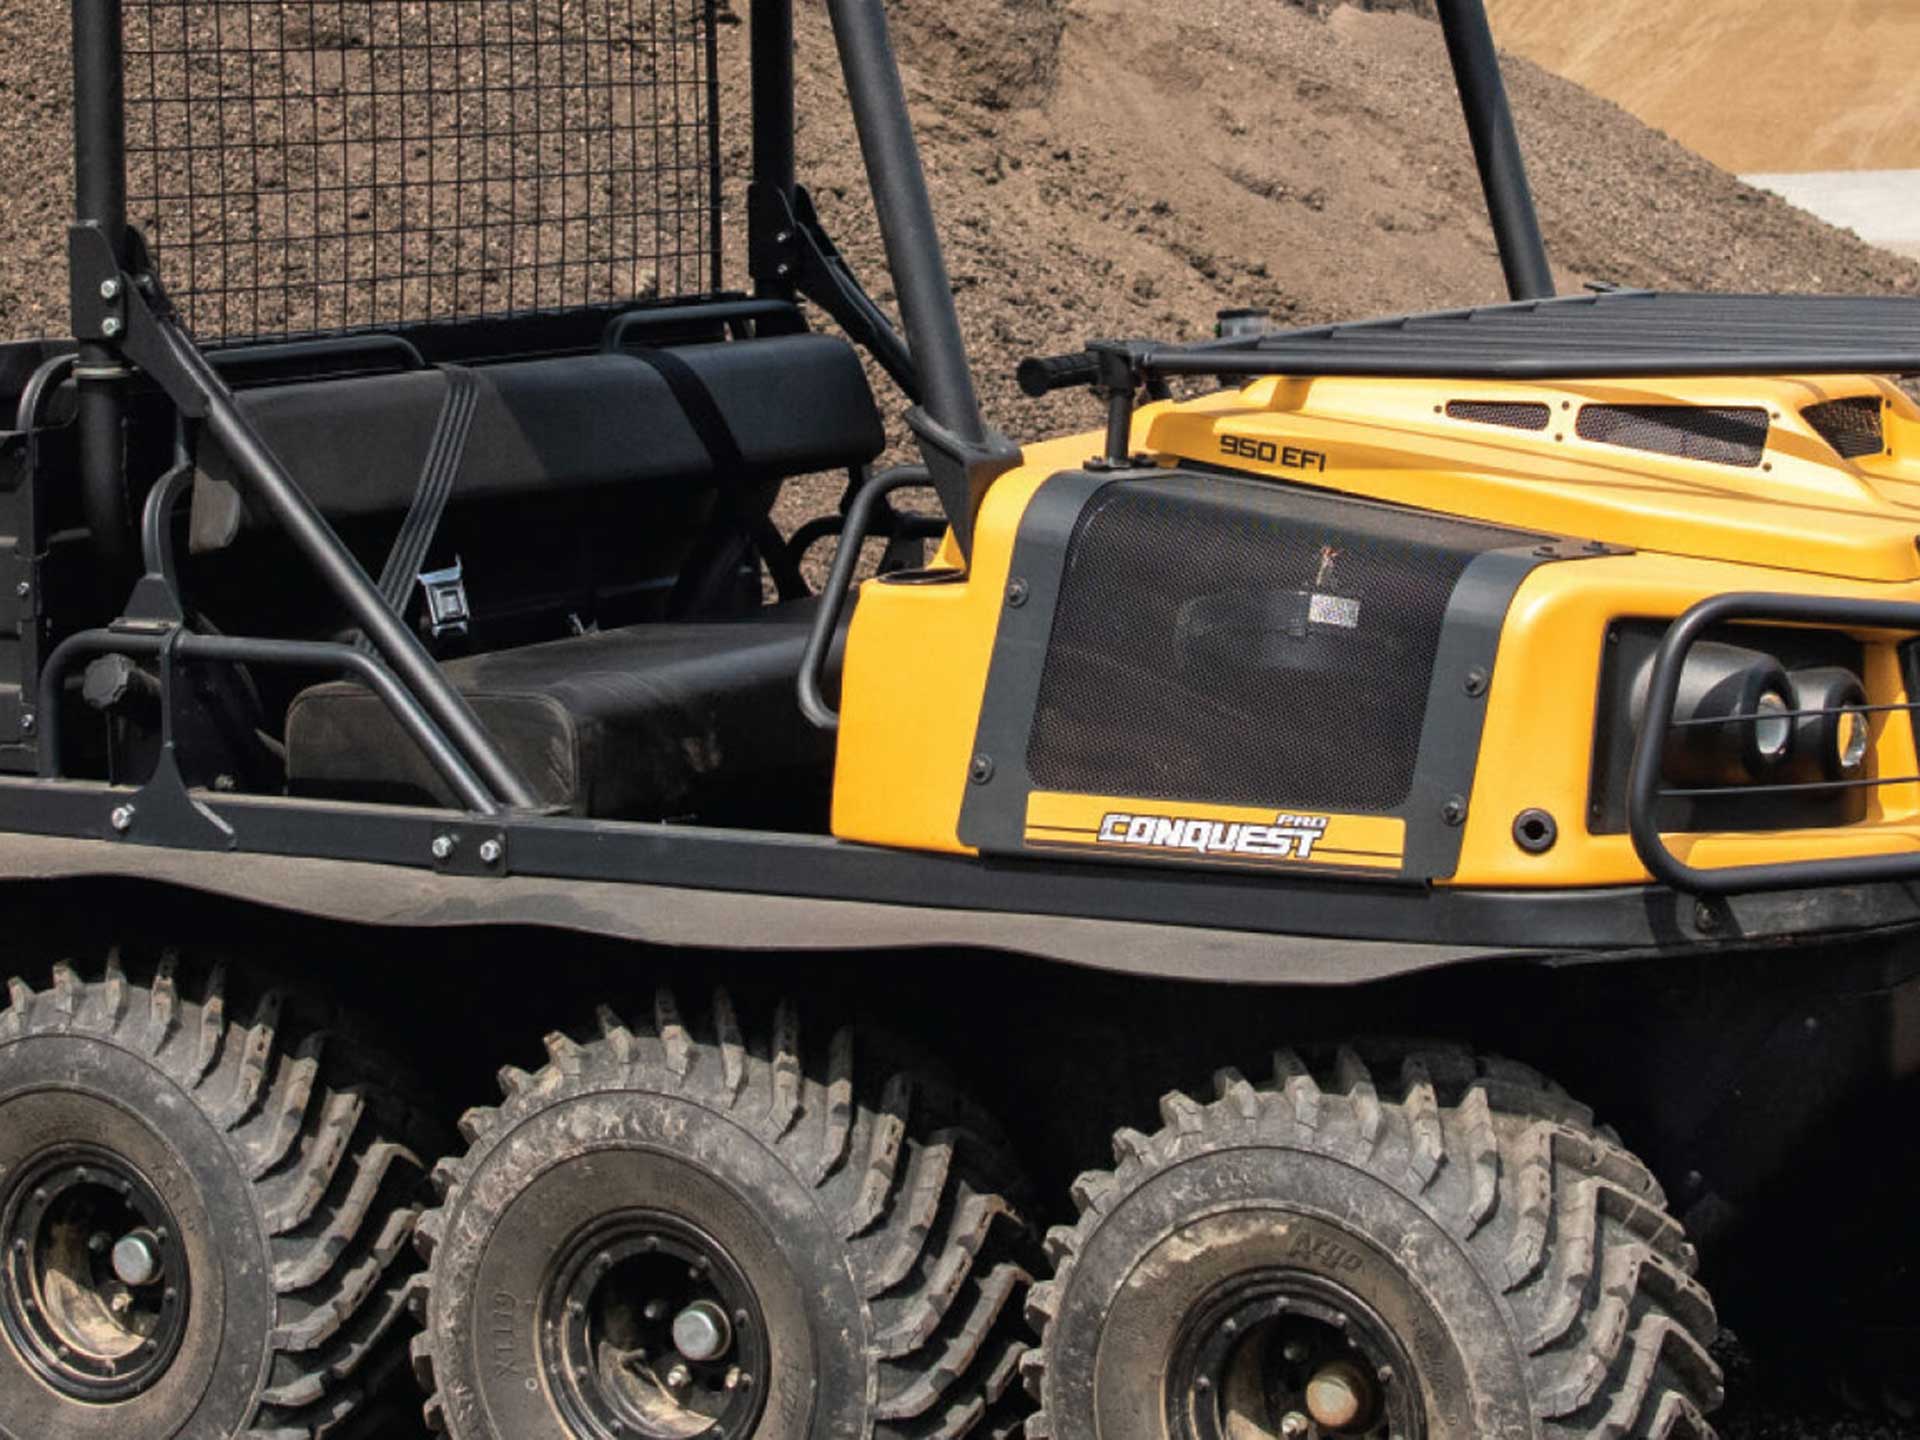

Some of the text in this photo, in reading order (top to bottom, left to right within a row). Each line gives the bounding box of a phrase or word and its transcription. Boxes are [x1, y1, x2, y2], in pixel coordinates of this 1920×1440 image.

[1220, 435, 1326, 472] 950 EFI
[1098, 813, 1323, 858] CONQUEST
[1276, 813, 1328, 828] PRO
[1288, 1230, 1363, 1272] Argo
